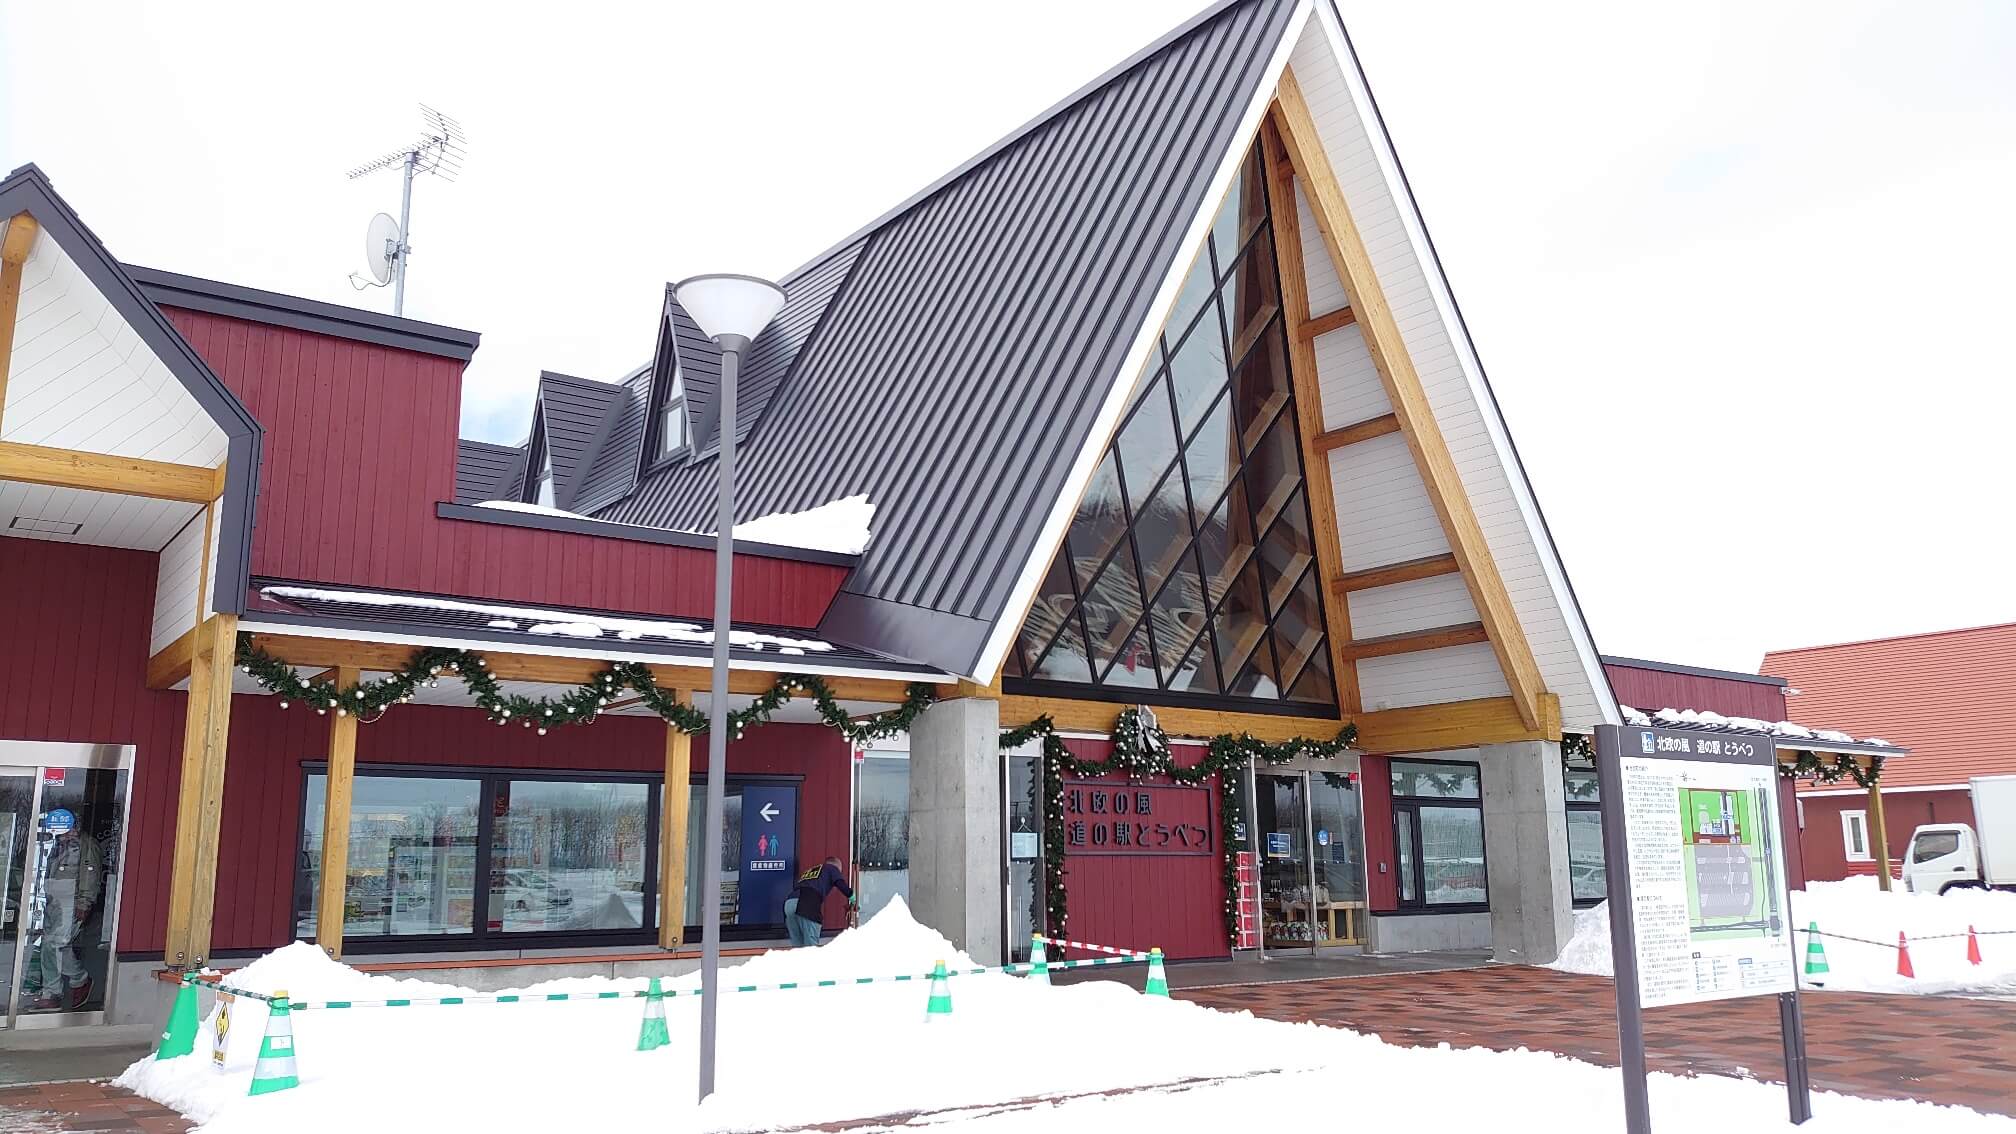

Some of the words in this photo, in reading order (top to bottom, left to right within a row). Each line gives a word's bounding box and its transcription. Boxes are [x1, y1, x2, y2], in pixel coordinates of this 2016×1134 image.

[1657, 736, 1690, 752] 北欧の風
[1696, 739, 1720, 755] 道の駅
[1724, 741, 1754, 757] とうべつ
[1069, 789, 1151, 815] 北欧の風
[1069, 820, 1208, 847] 道の駅とうべつ
